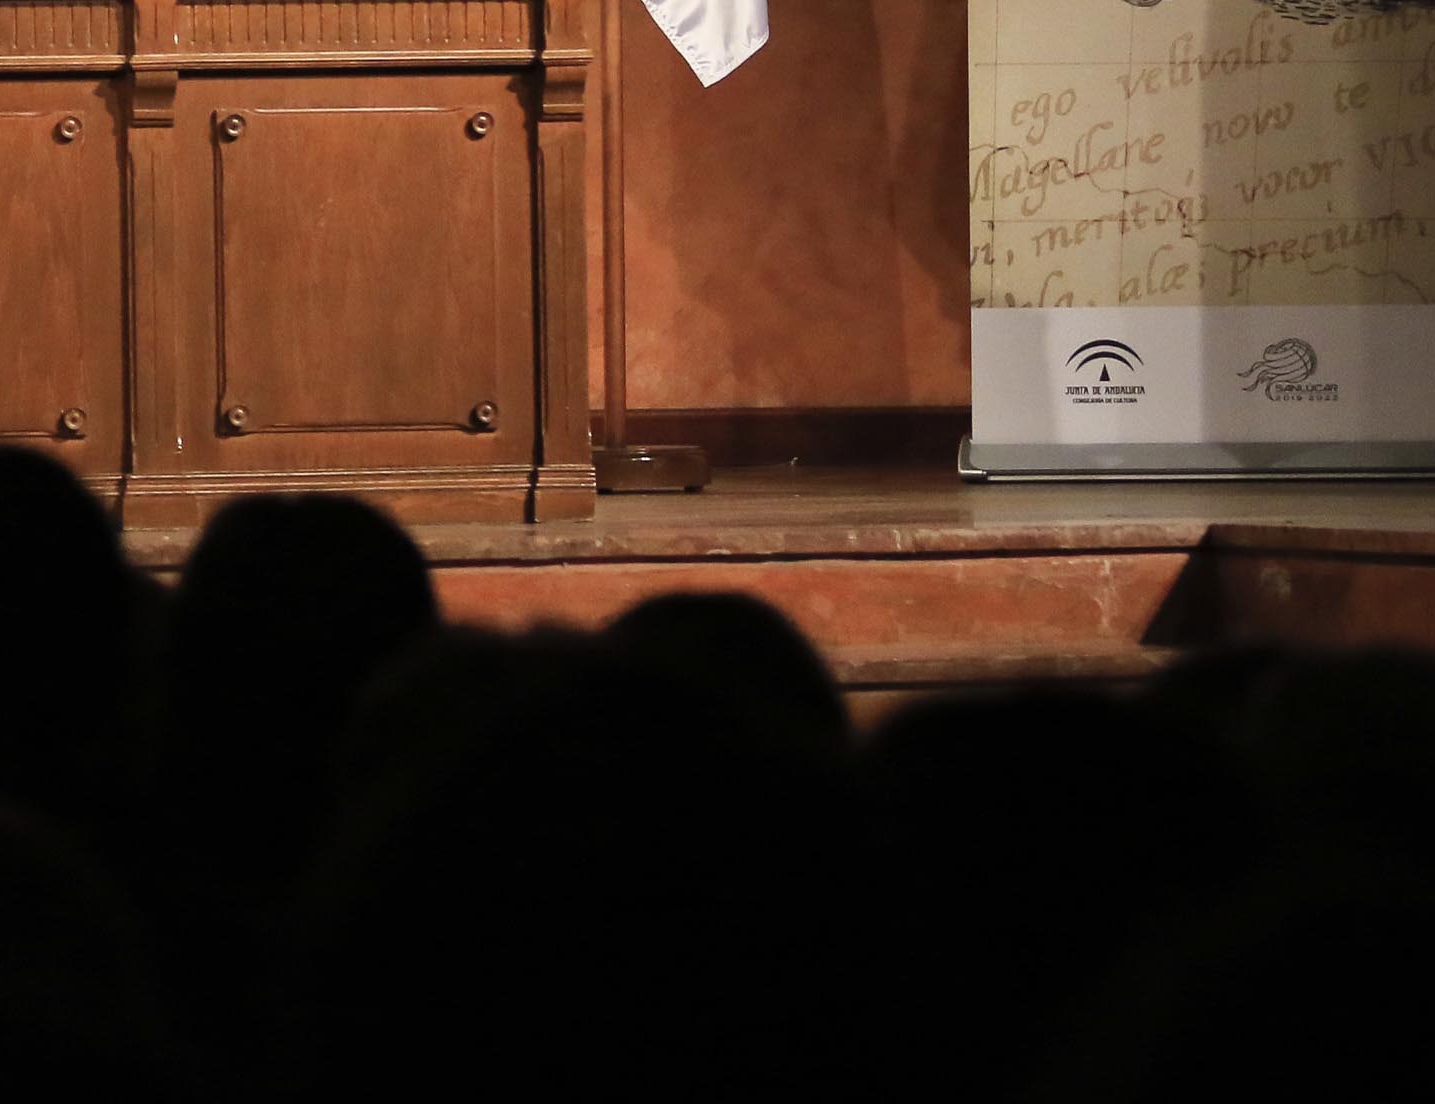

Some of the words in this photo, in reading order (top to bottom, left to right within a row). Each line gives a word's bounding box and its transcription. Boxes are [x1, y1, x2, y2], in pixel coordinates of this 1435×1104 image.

[1010, 87, 1077, 145] ego
[1065, 385, 1090, 395] JUNTA
[1092, 385, 1102, 395] DE
